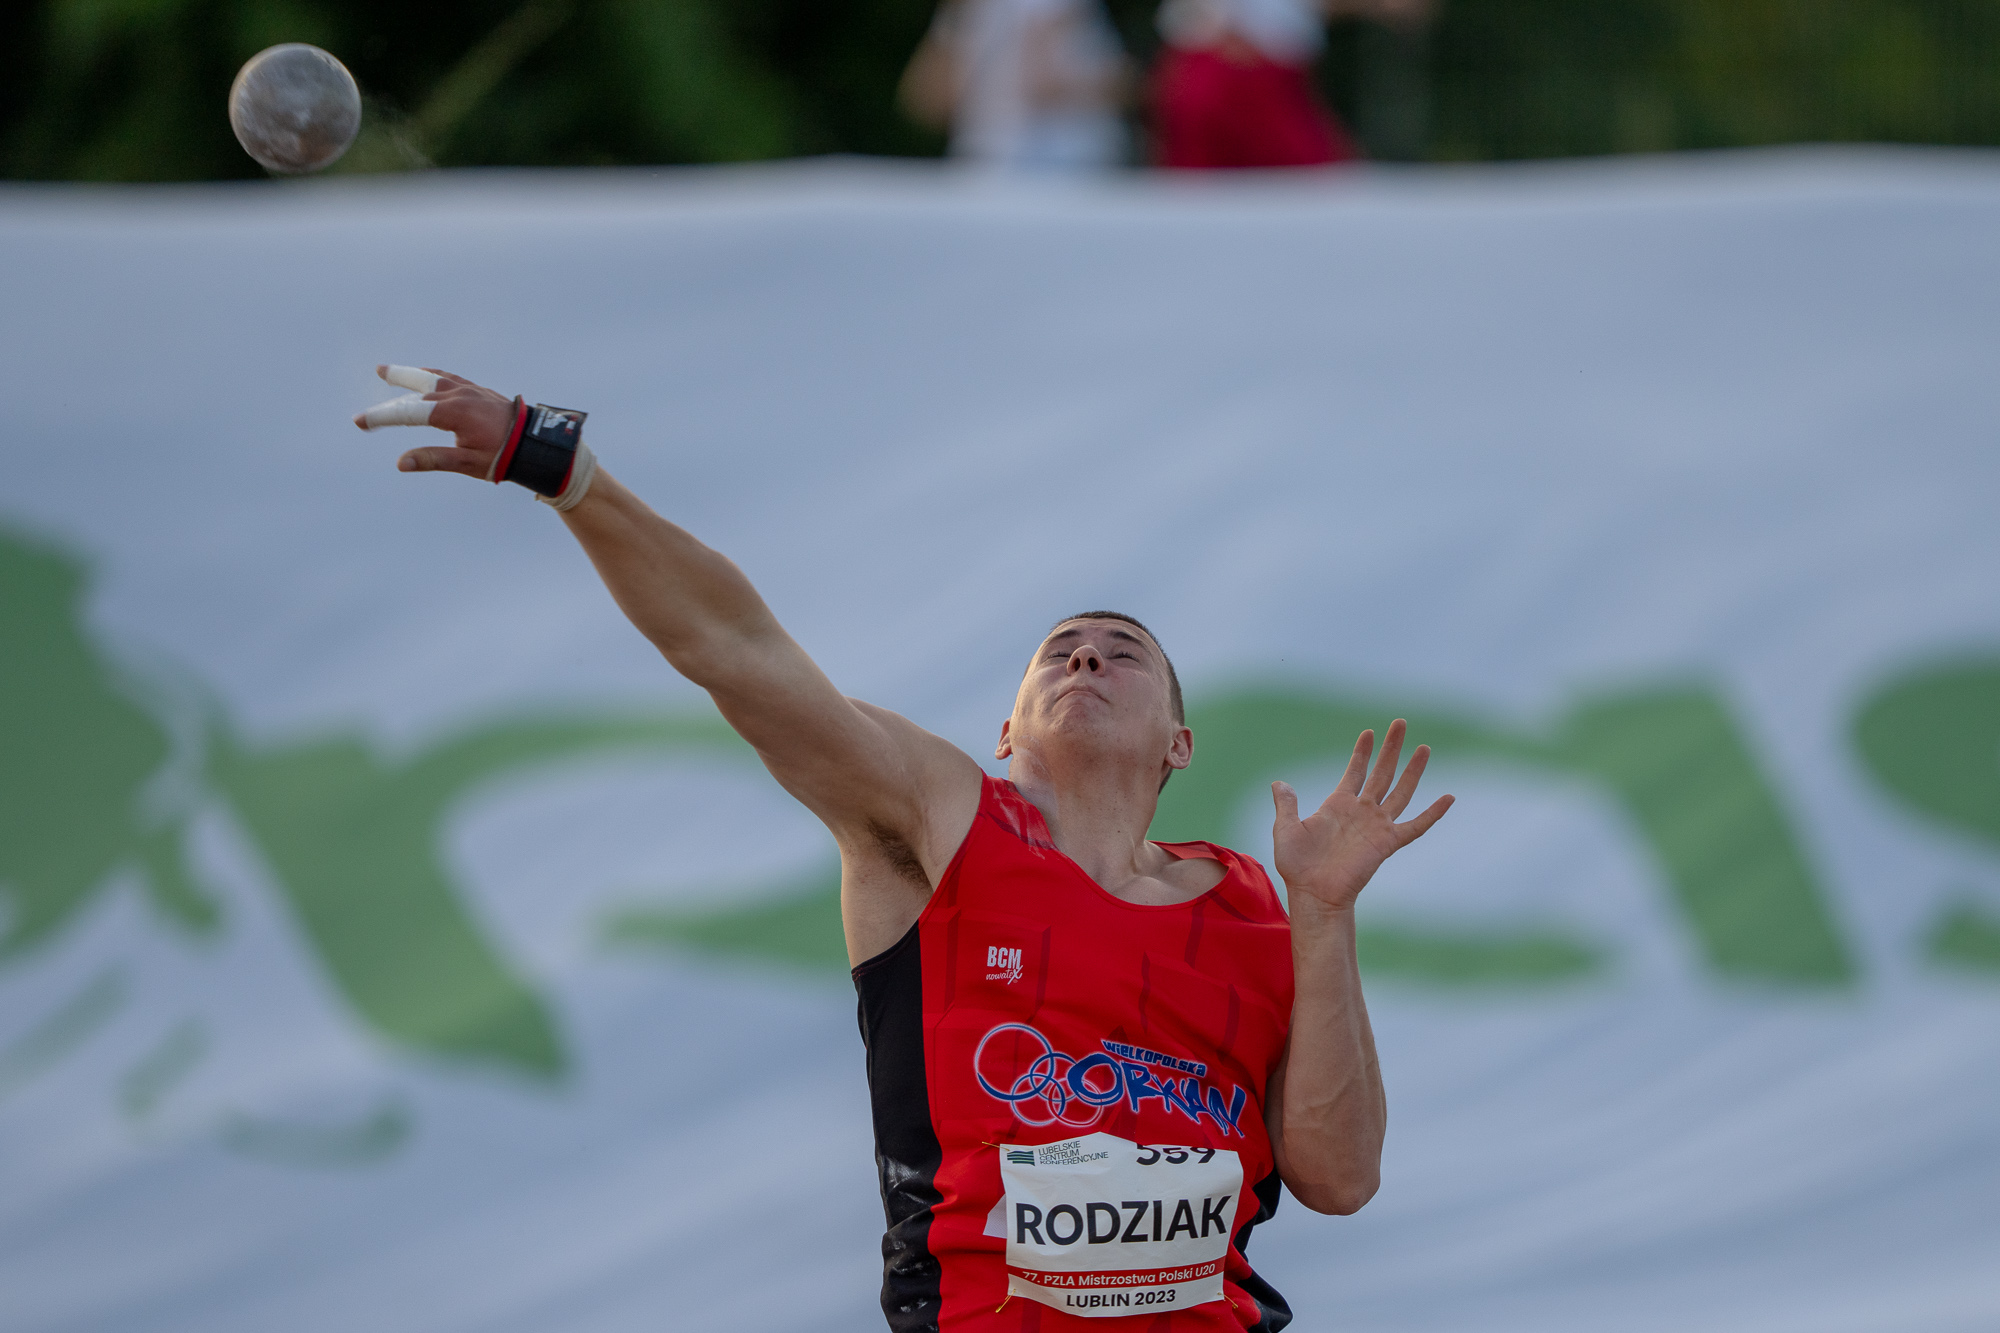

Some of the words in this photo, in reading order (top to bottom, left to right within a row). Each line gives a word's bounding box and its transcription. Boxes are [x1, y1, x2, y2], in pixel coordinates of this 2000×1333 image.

[986, 946, 1022, 970] BCM
[1038, 1140, 1082, 1156] LUBELSKIE
[1039, 1148, 1080, 1162] CENTRUM
[1039, 1151, 1109, 1166] KONFERENCYJNE
[1016, 1195, 1232, 1245] RODZIAK
[1022, 1271, 1041, 1284] 77.
[1044, 1275, 1076, 1287] PZLA
[1078, 1273, 1156, 1287] Mistrzostwa
[1159, 1267, 1193, 1281] Polski
[1195, 1263, 1216, 1277] U20
[1066, 1293, 1130, 1308] LUBLIN
[1134, 1289, 1176, 1305] 2023
